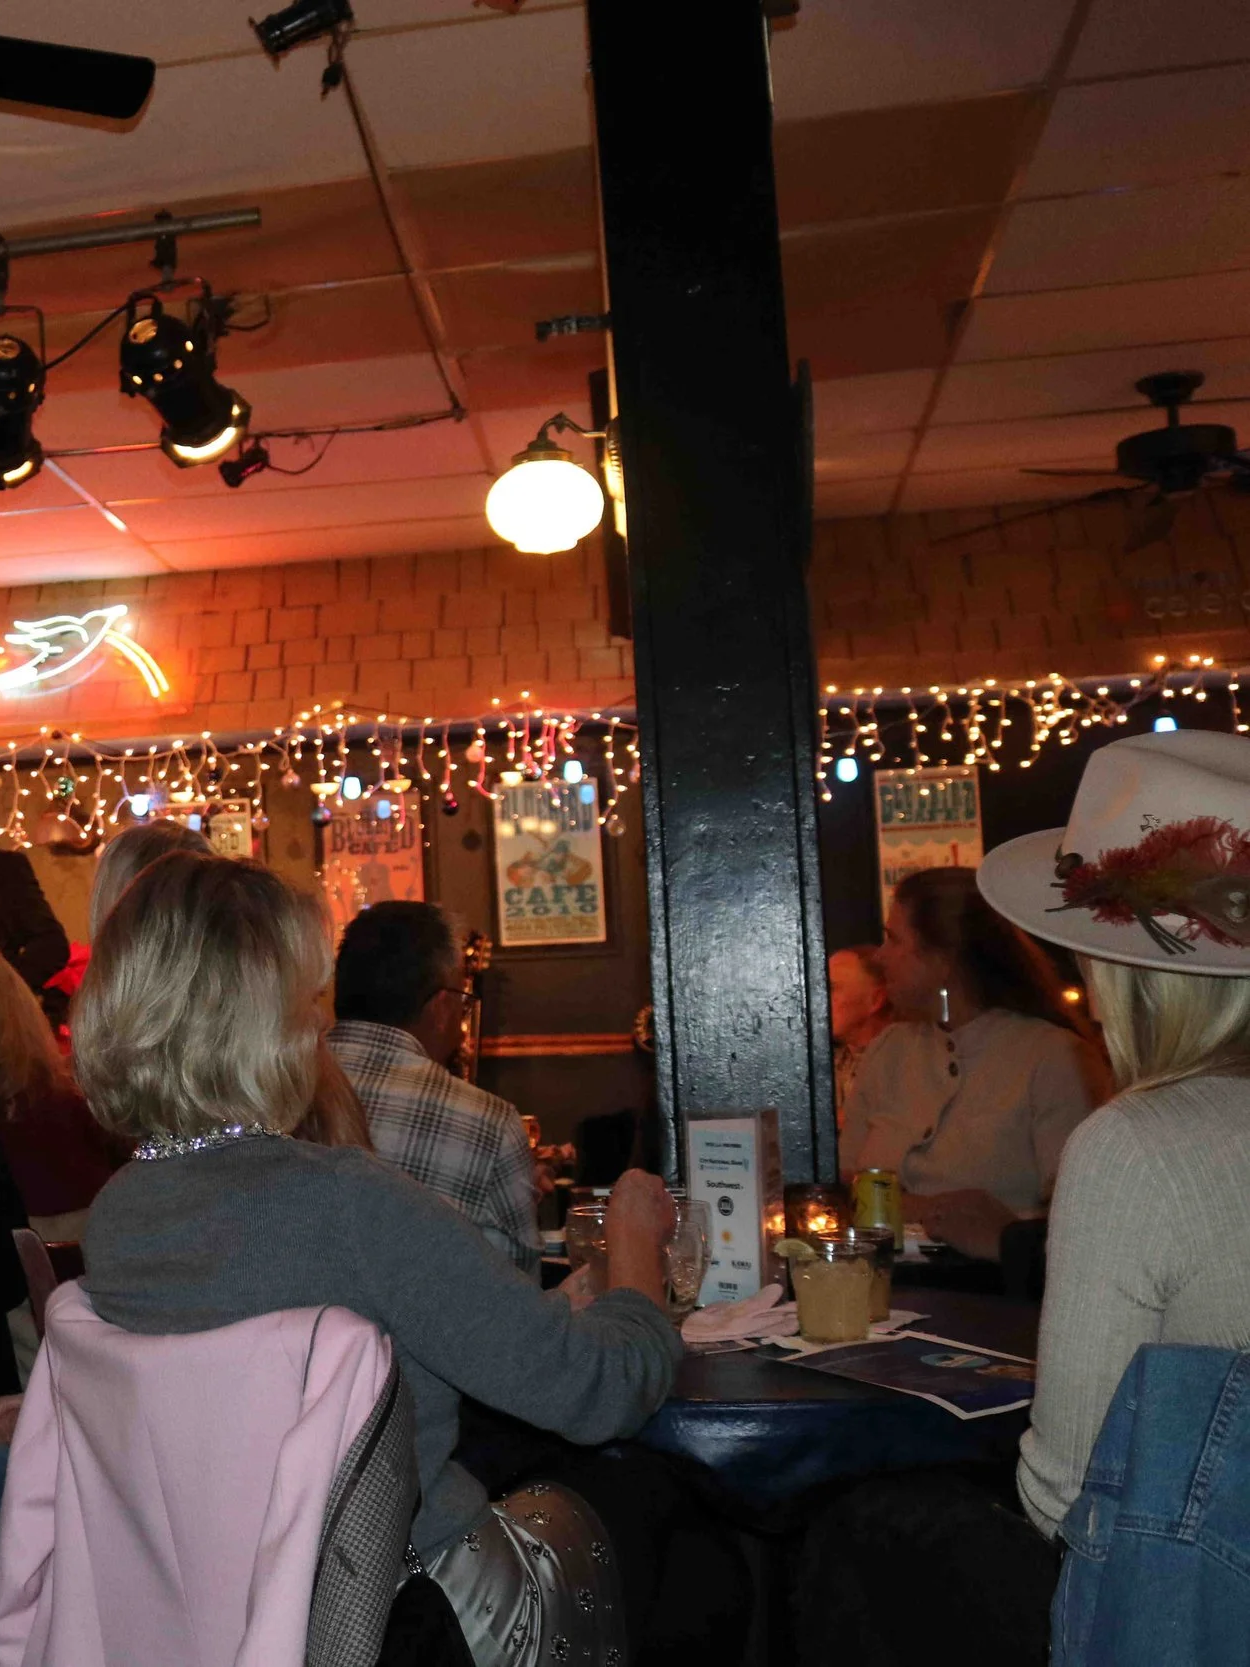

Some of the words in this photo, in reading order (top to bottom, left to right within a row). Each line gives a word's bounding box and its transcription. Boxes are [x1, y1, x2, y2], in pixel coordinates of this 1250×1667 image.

[350, 841, 400, 855] CAFE
[504, 884, 598, 906] CAFE
[505, 903, 598, 917] 2010
[706, 1180, 741, 1190] Southwest
